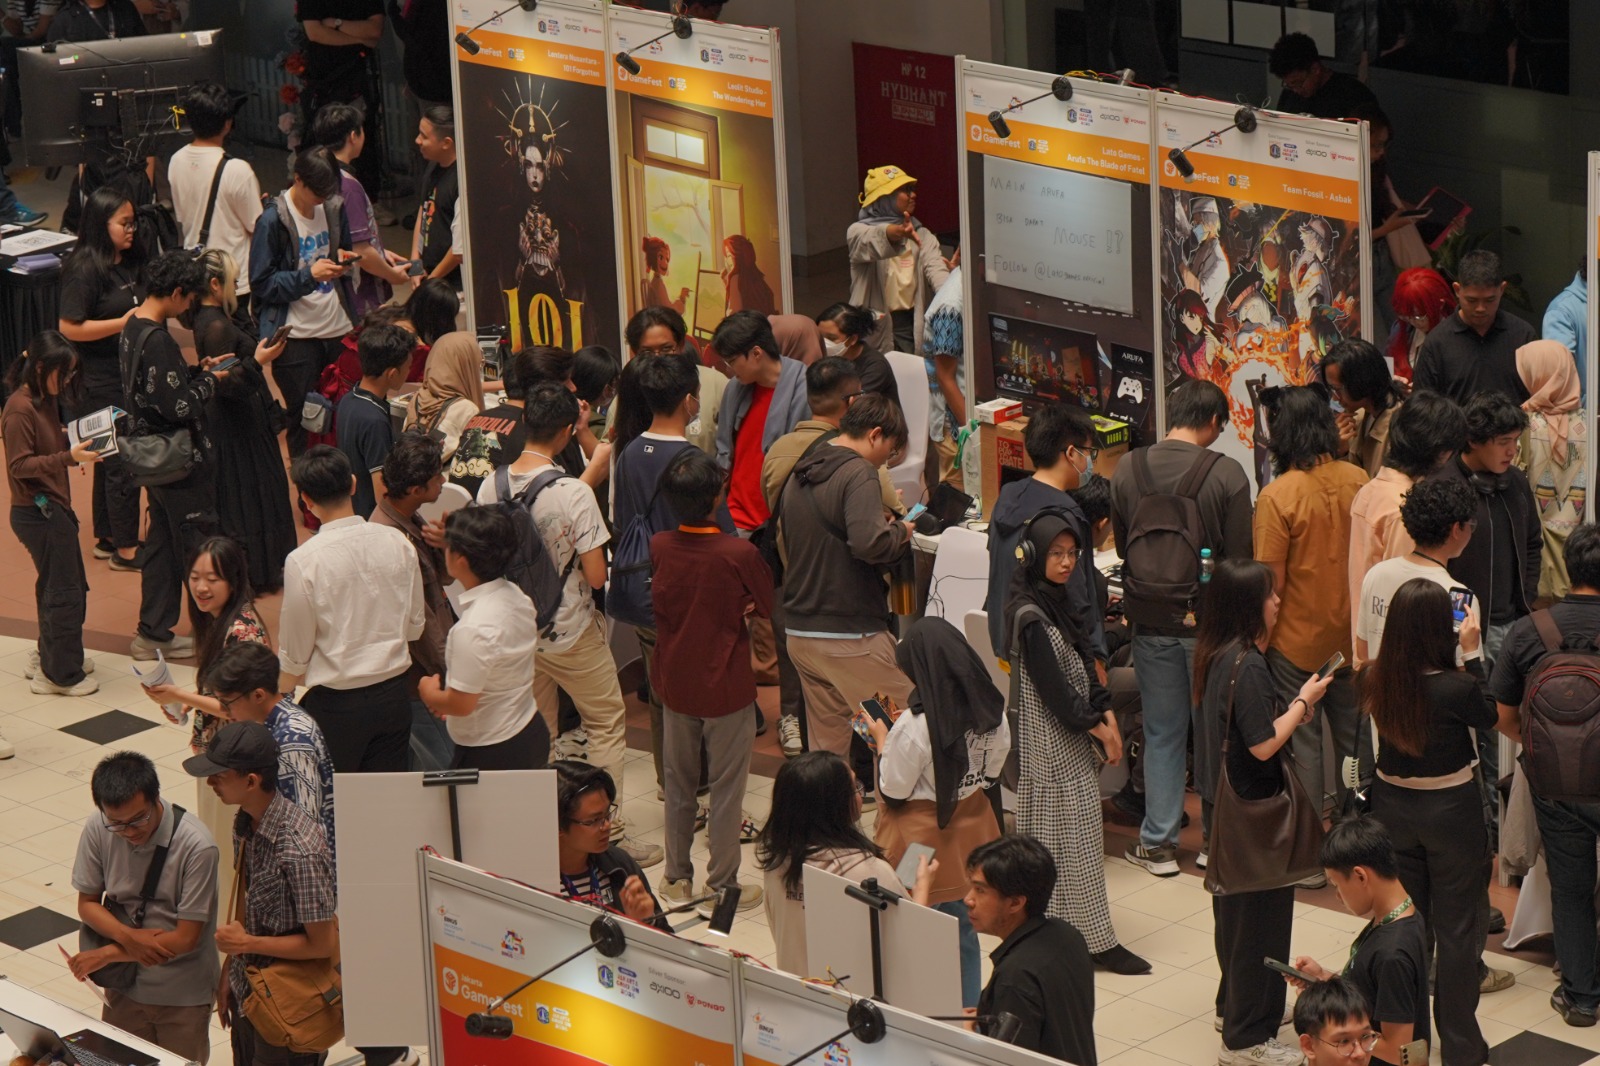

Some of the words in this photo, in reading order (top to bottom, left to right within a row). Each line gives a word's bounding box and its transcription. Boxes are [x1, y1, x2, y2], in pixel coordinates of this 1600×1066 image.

[480, 48, 502, 58] meFest
[548, 49, 568, 60] Lentera
[569, 54, 597, 65] Nusantara
[564, 64, 574, 72] 101
[574, 66, 600, 78] Forgotten
[915, 66, 926, 79] 12
[629, 74, 662, 87] GameFest
[745, 84, 764, 96] Studio
[881, 81, 947, 107] HYDRANT
[713, 91, 724, 100] The
[724, 93, 754, 106] Wandering
[756, 99, 766, 108] Her
[984, 134, 1020, 149] GameFest
[1102, 147, 1118, 158] Lato
[1118, 149, 1141, 162] Games
[1087, 156, 1100, 167] The
[1100, 159, 1119, 170] Blade
[1120, 162, 1127, 172] of
[1128, 163, 1146, 175] Fatel
[990, 177, 1026, 192] MAIN
[1282, 184, 1303, 196] Team
[1304, 187, 1324, 199] Fossil
[1330, 193, 1352, 204] Asbak
[1054, 226, 1096, 248] MOUSE
[503, 287, 584, 355] 101
[1122, 352, 1144, 364] ARUFA
[461, 974, 483, 988] Jakarta
